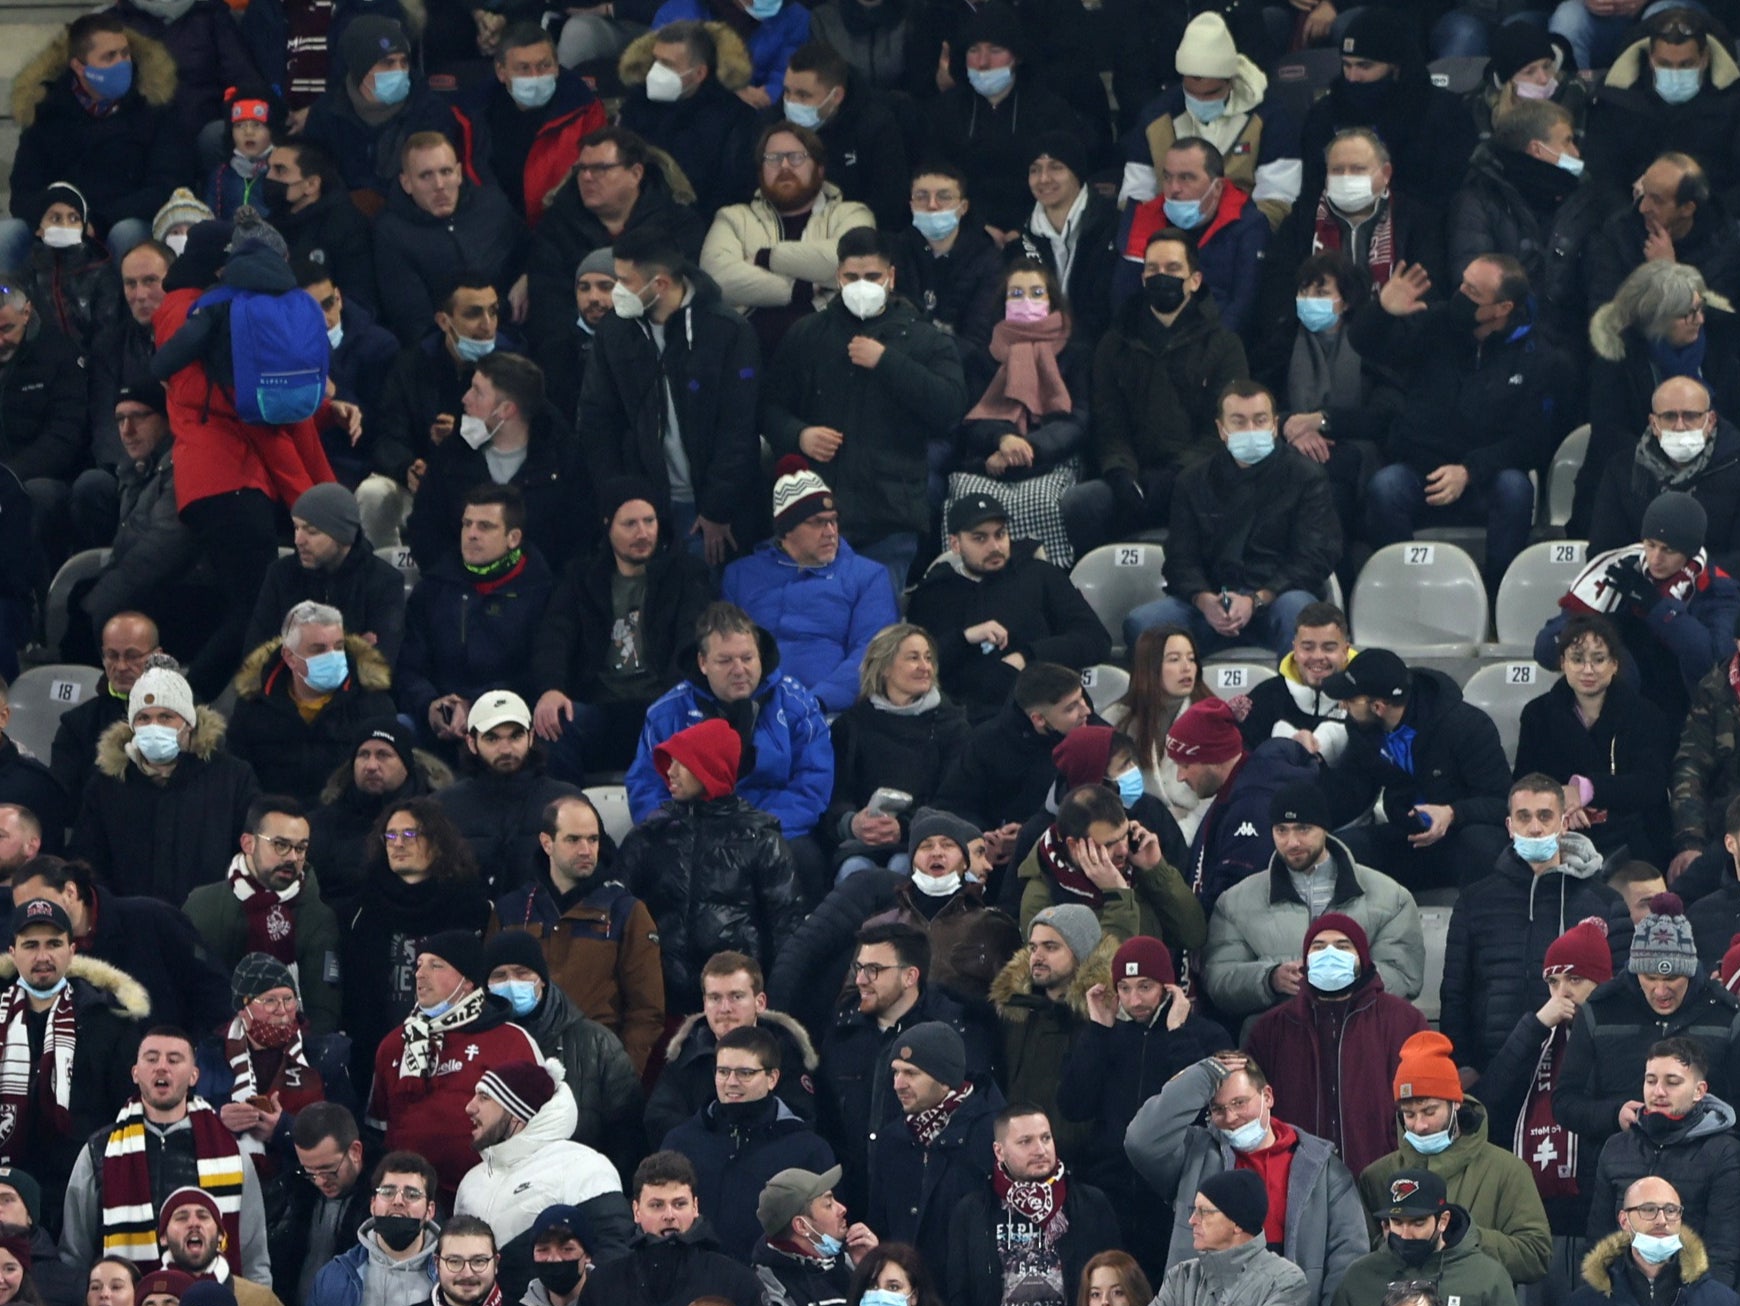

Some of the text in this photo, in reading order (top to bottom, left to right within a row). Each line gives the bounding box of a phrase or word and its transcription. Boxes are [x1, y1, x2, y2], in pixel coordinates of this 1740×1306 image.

[1121, 550, 1138, 565] 25
[1411, 548, 1428, 563] 27
[1556, 546, 1573, 562] 28
[1224, 671, 1241, 686] 26
[1512, 667, 1530, 683] 28
[60, 683, 73, 701] 18
